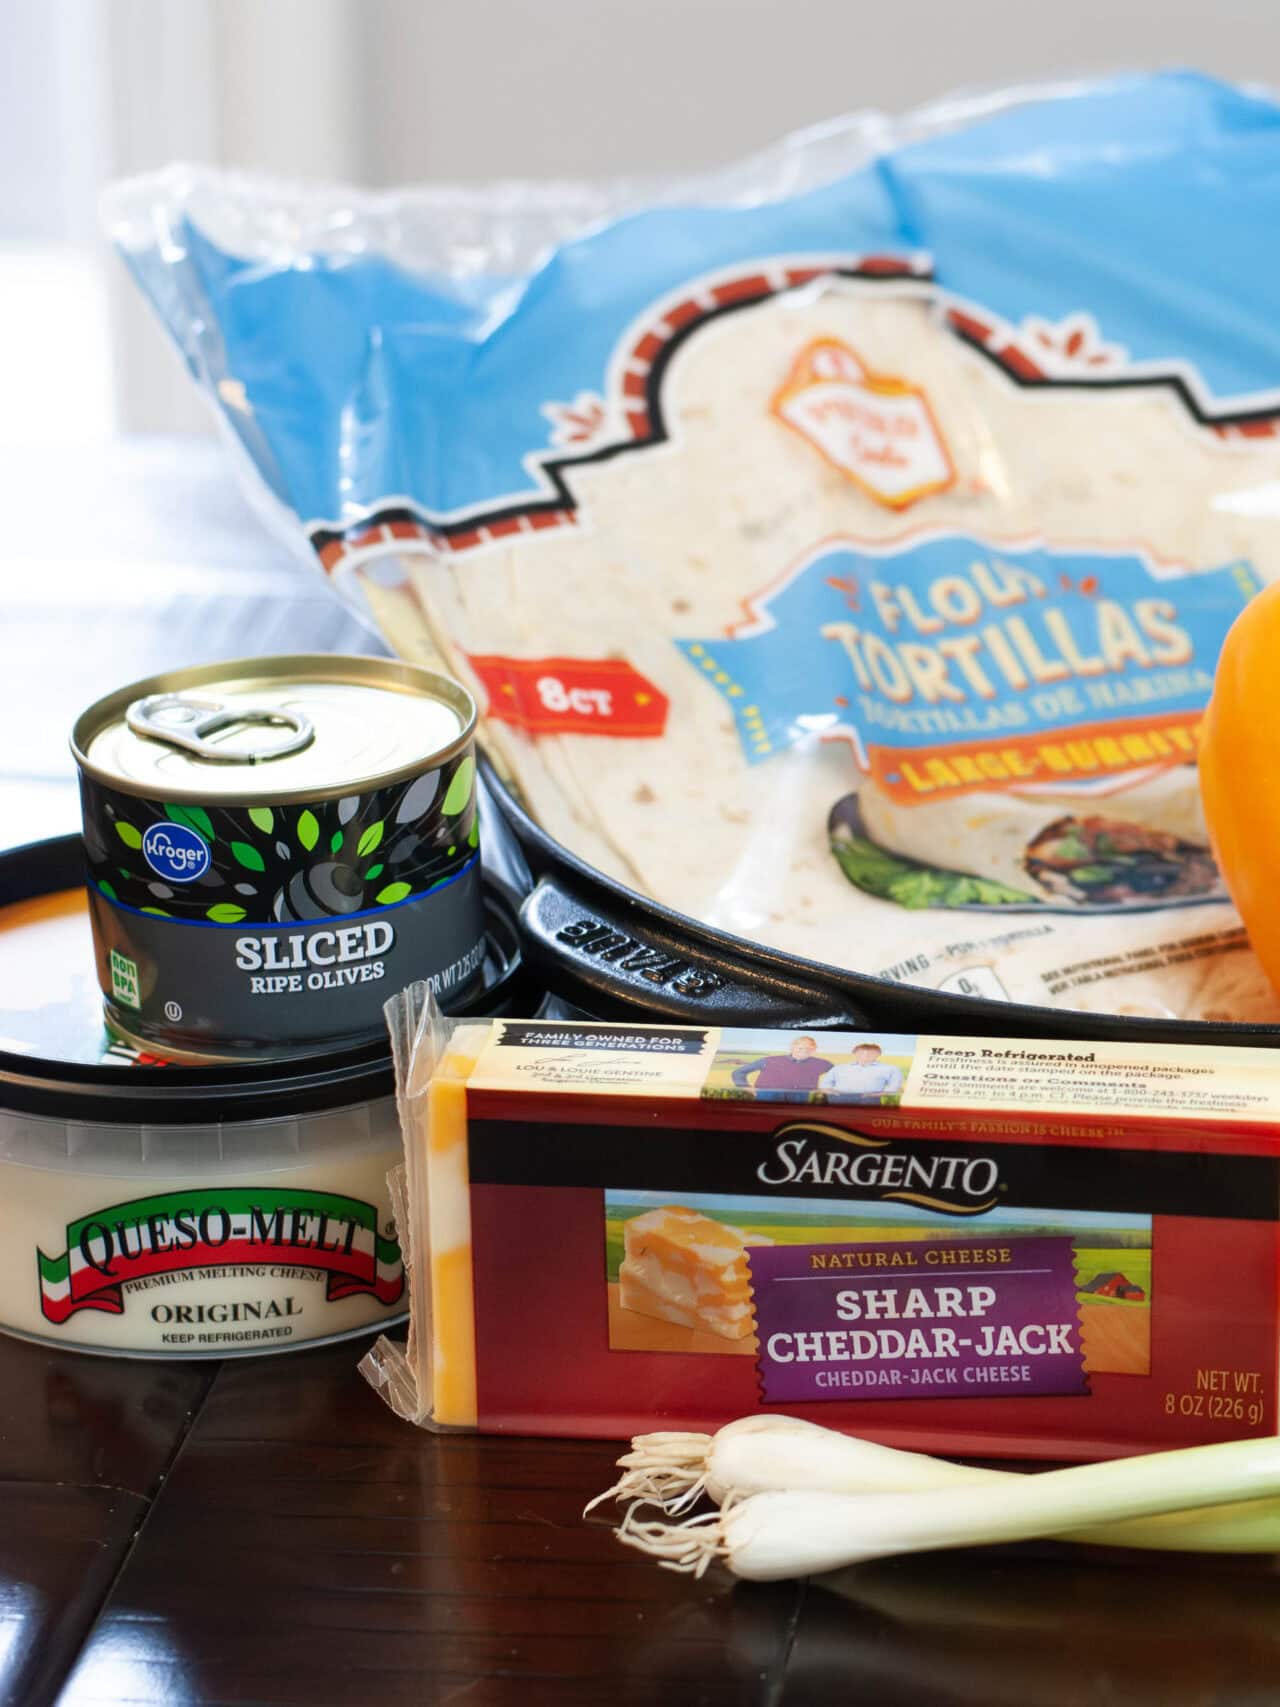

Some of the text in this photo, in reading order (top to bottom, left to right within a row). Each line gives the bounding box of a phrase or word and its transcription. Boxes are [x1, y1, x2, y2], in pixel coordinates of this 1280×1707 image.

[820, 597, 1194, 703] TORTILLAS
[146, 832, 204, 870] Kroger
[235, 920, 395, 971] SLICED
[113, 971, 137, 996] BPA
[251, 961, 385, 994] RIPE OLIVES
[519, 1038, 686, 1051] THREE GENERATIONS
[525, 1032, 683, 1045] FAMILY OWNED FOR
[928, 1056, 993, 1064] Freshness
[1010, 1059, 1063, 1067] assured
[1081, 1063, 1149, 1071] unopened
[1152, 1066, 1215, 1075] packages
[931, 1047, 1095, 1062] Keep Refrigerated
[560, 1067, 600, 1075] LOUIE
[923, 1073, 1017, 1083] Questions
[1047, 1078, 1147, 1089] Comments
[1018, 1067, 1076, 1075] stamped
[872, 1119, 900, 1129] OUR
[757, 1140, 999, 1196] SARGENTO
[80, 1205, 365, 1277] QUESO-MELT
[810, 1248, 1012, 1269] NATURAL CHEESE
[124, 1265, 324, 1294] PREMIUM MELTING CHEESE
[151, 1296, 303, 1324] ORIGINAL
[836, 1286, 997, 1321] SHARP
[161, 1326, 293, 1344] KEEP REFRIGERATED
[767, 1324, 1075, 1363] CHEDDAR-JACK
[815, 1365, 1031, 1388] CHEDDAR-JACK CHEESE
[1196, 1369, 1264, 1394] NET WT.
[1165, 1393, 1264, 1425] 8 OZ (226 g)
